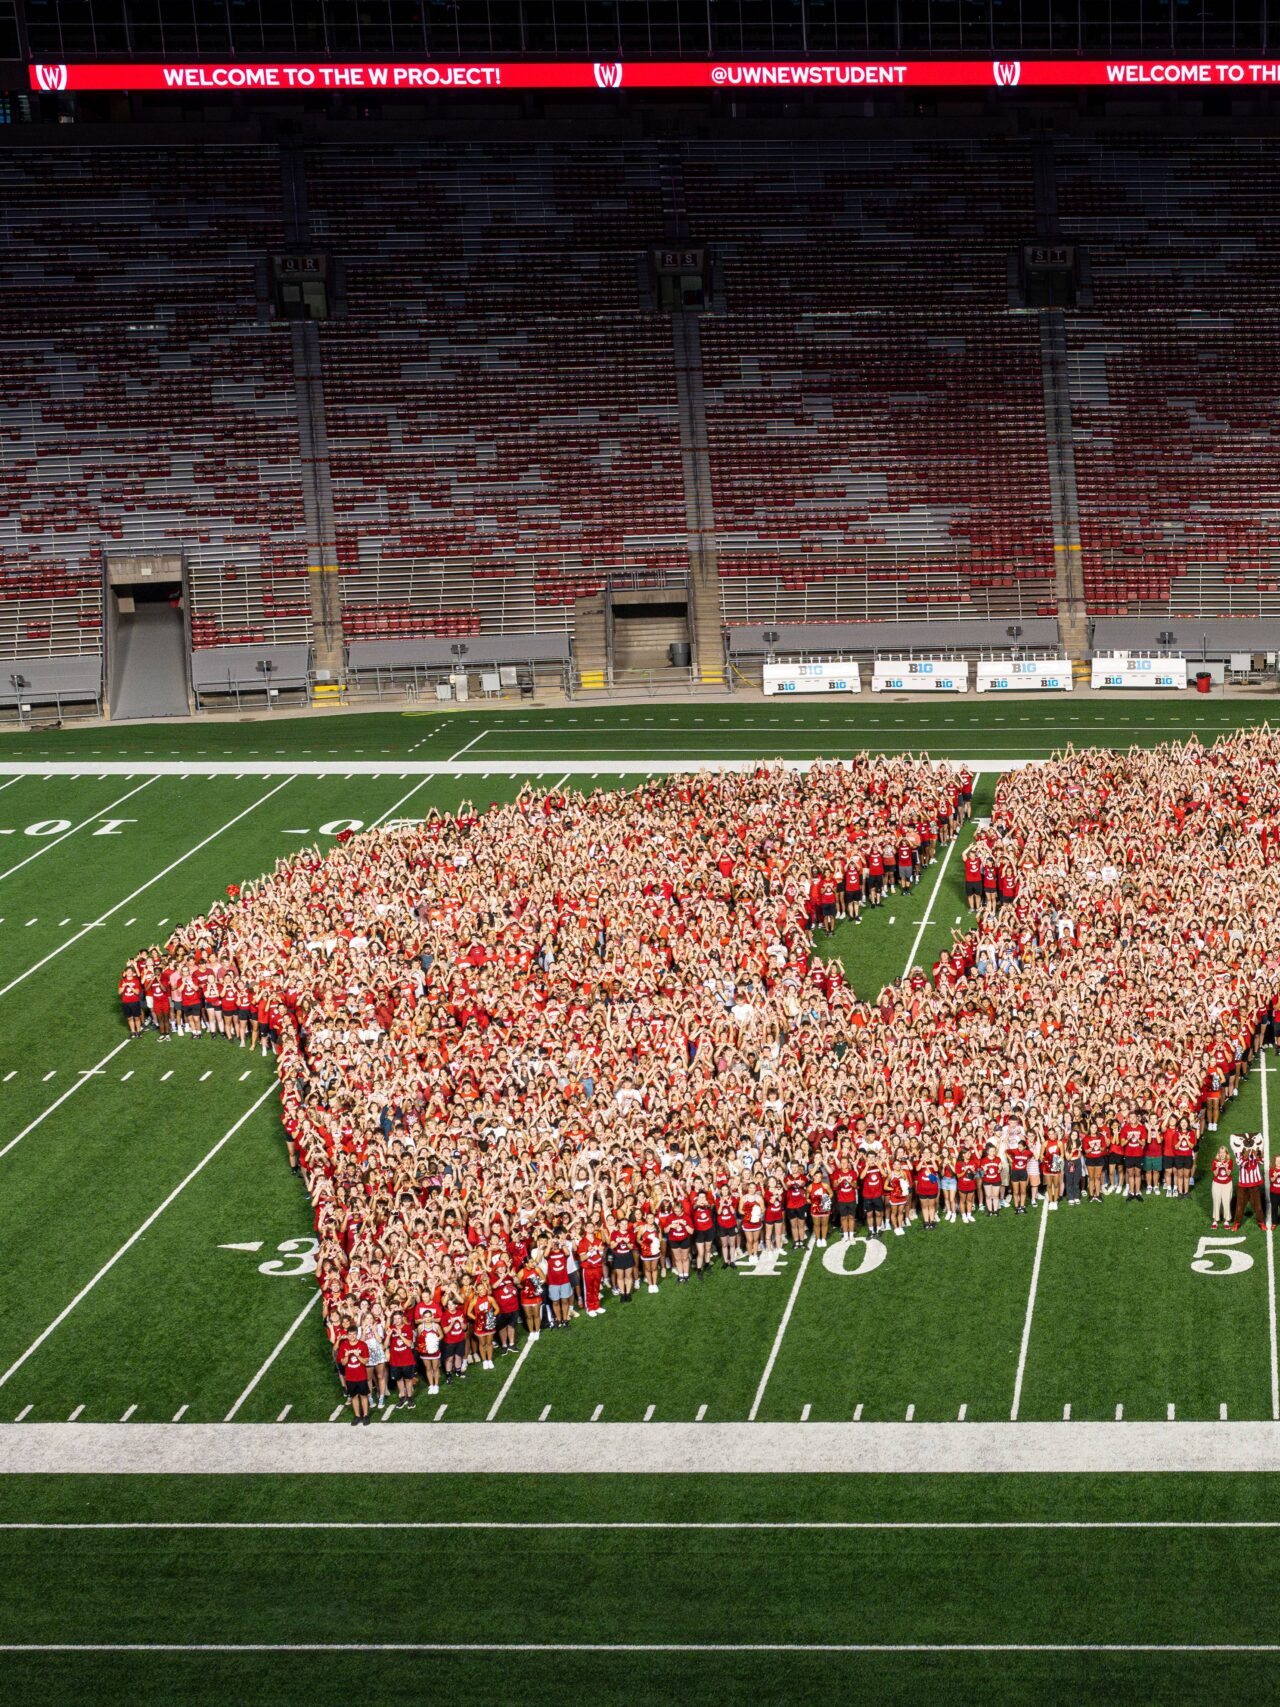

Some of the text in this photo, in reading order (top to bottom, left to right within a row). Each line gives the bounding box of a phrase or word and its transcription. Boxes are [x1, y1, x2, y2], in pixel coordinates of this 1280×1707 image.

[163, 68, 501, 86] WELCOME TO THE W PROJECT!
[711, 66, 908, 84] @UWNEWSTUDENT
[1106, 65, 1212, 82] WELCOME
[1216, 65, 1245, 82] TO
